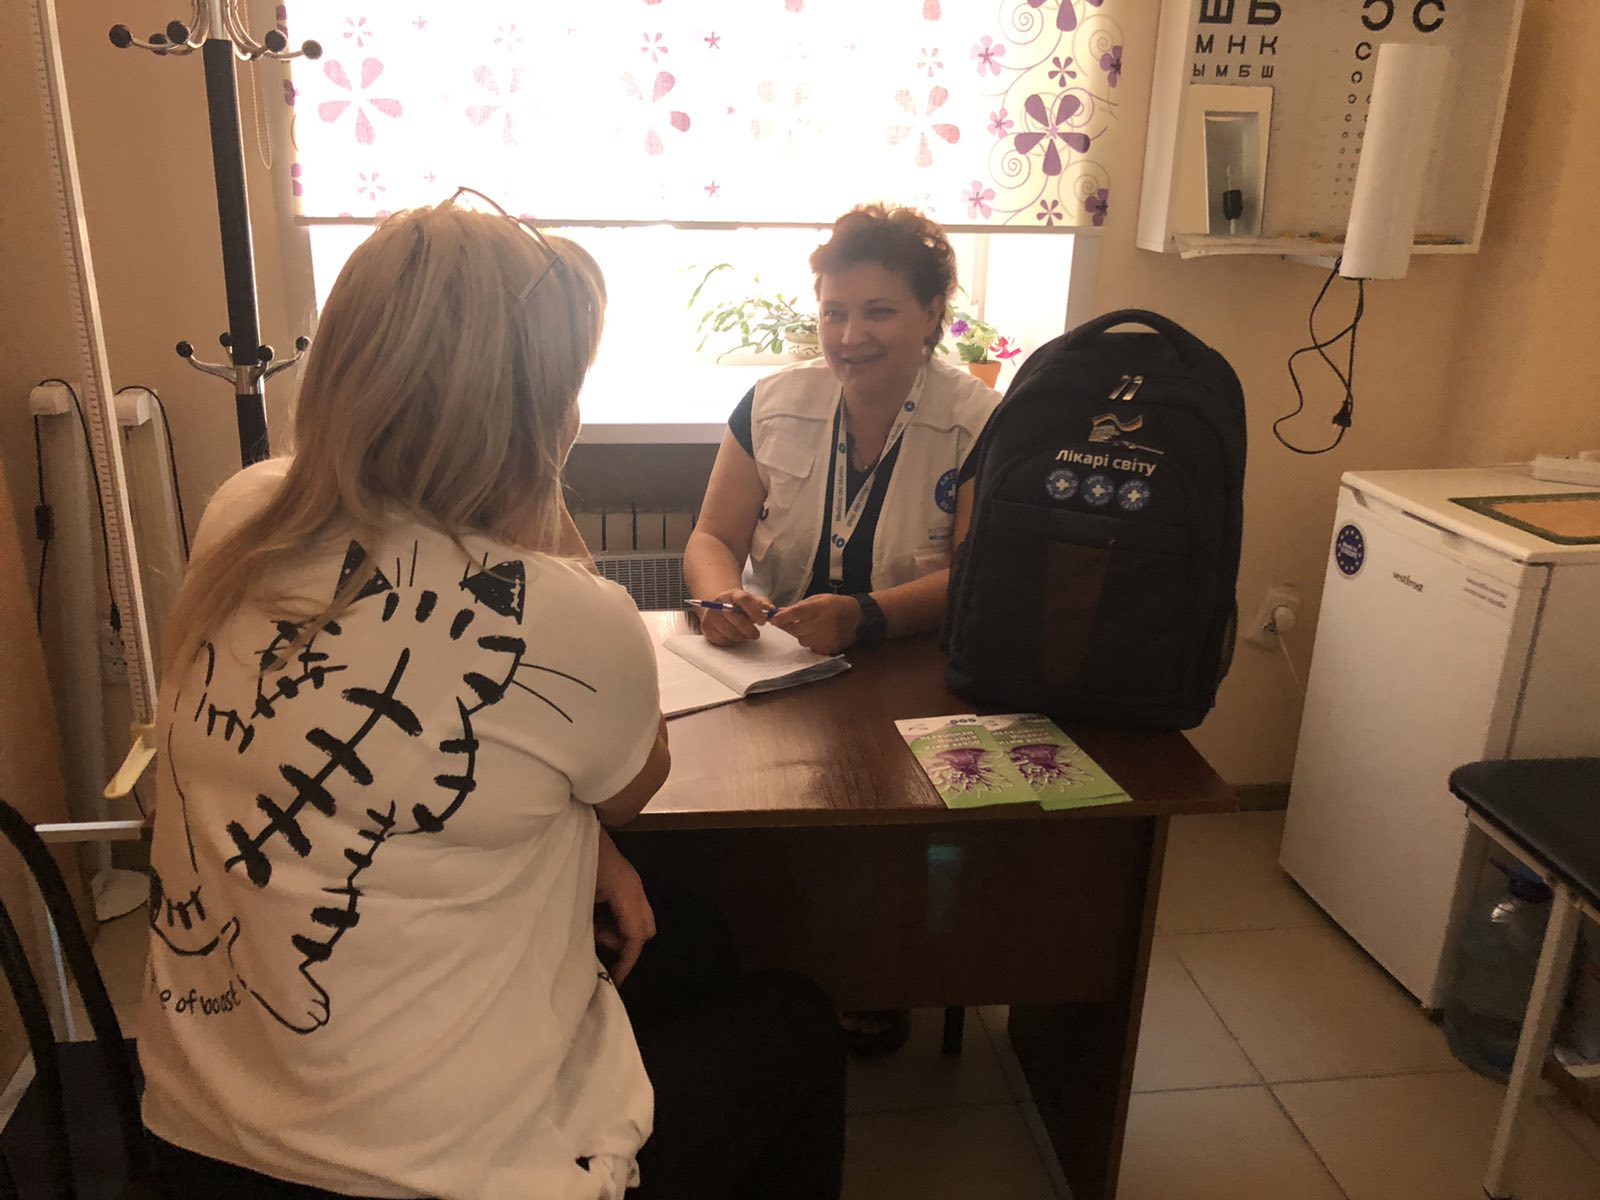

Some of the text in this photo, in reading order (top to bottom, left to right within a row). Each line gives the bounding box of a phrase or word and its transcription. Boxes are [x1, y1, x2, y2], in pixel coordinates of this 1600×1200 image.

[1055, 449, 1157, 477] Лікарі світу
[175, 988, 198, 1015] of
